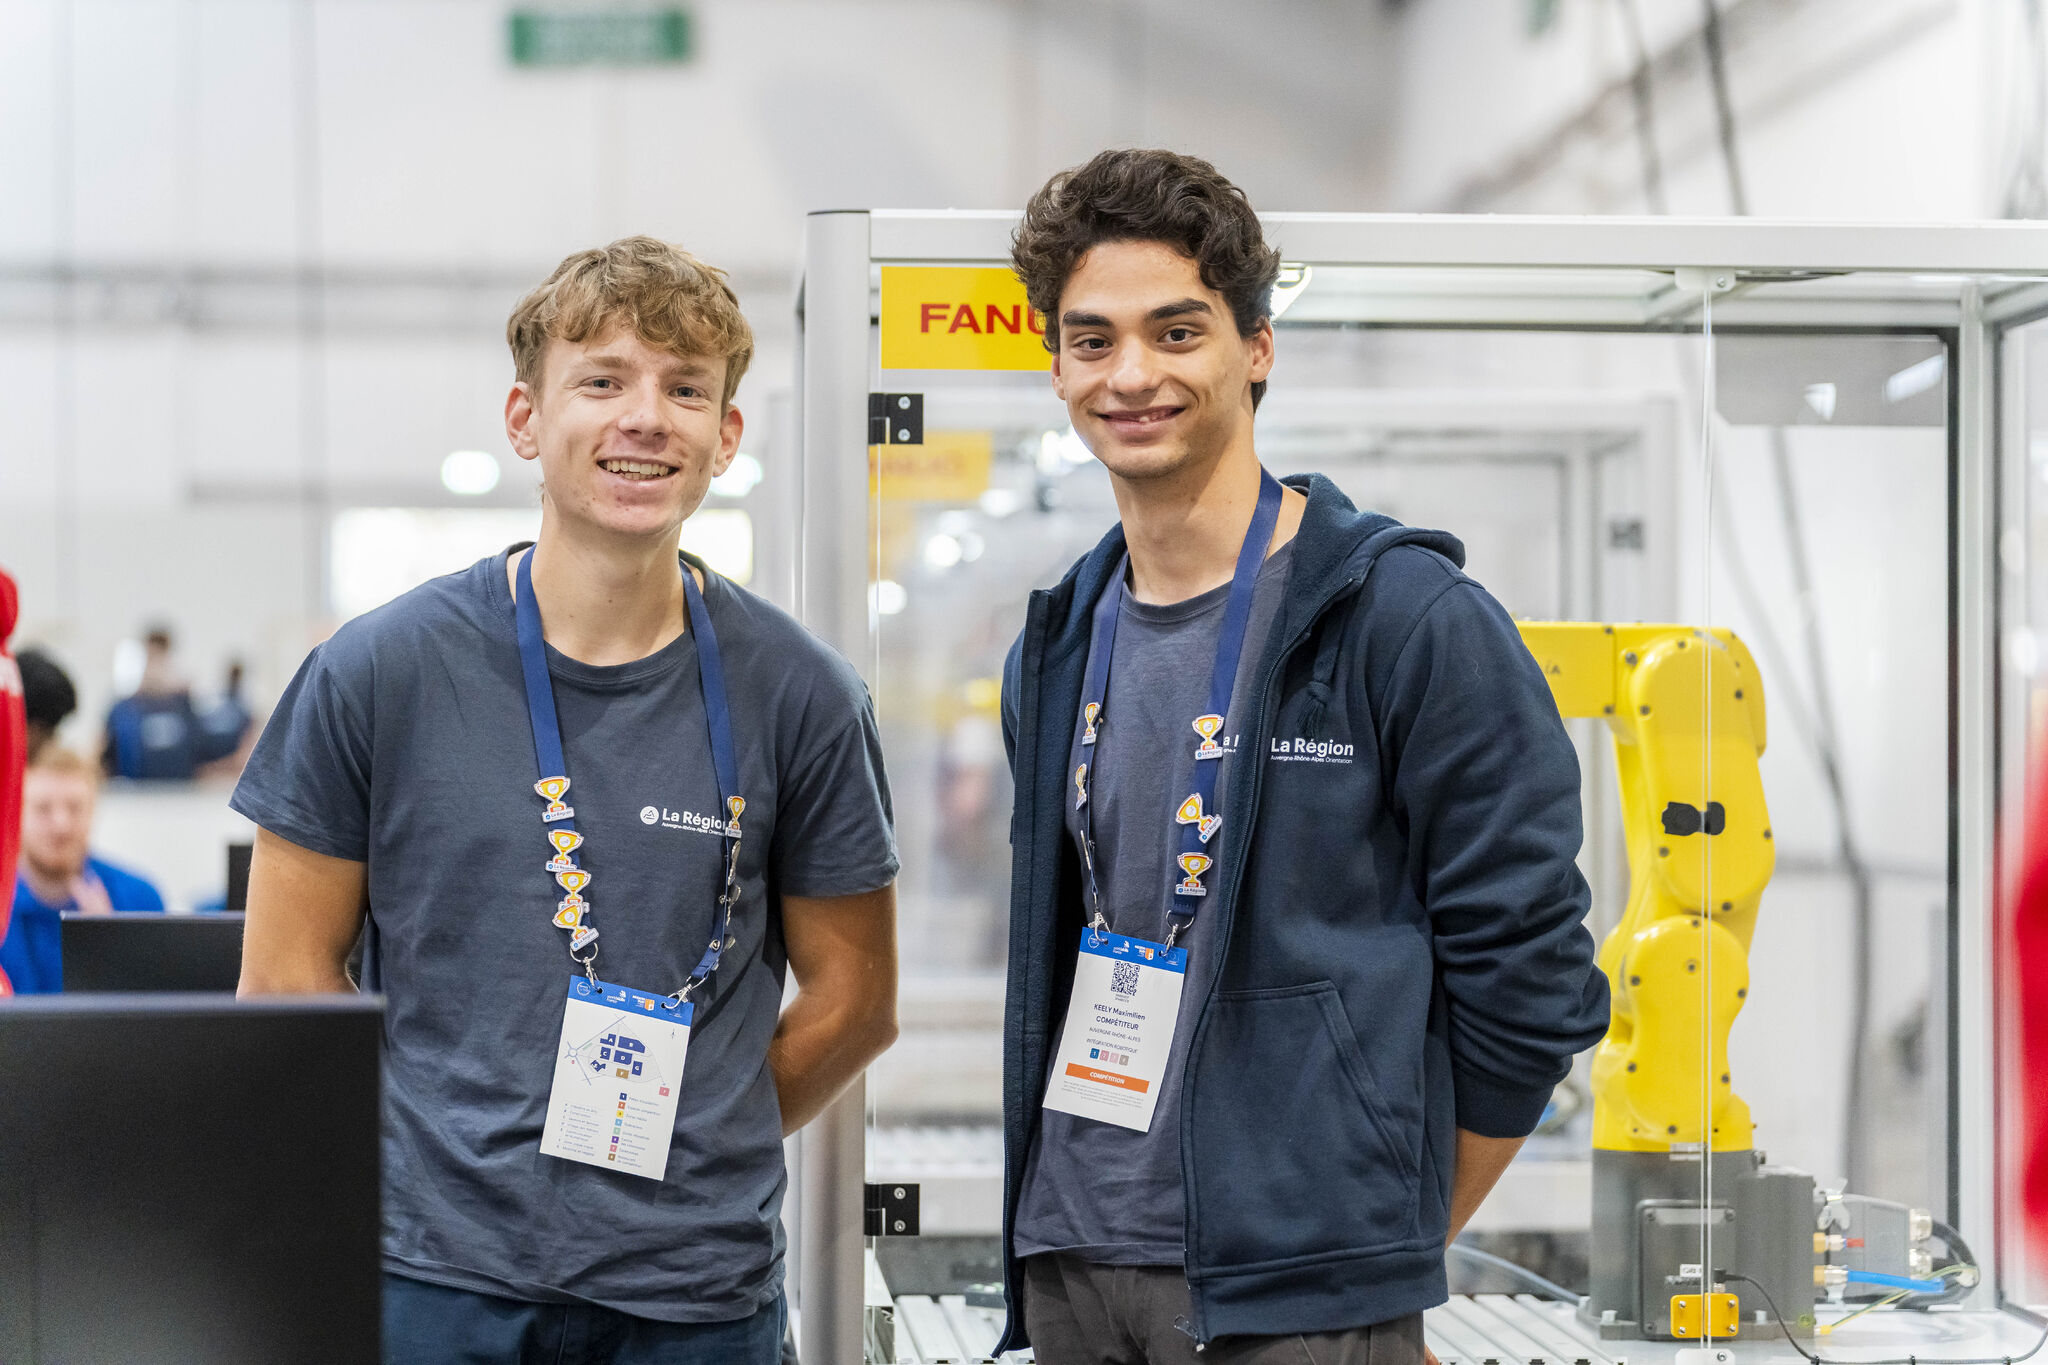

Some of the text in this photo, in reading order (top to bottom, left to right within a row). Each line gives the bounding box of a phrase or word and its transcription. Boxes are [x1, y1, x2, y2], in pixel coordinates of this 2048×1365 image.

[1271, 737, 1354, 758] La Région
[662, 808, 680, 822] La
[1093, 1003, 1146, 1020] KEELY Maximilien
[1096, 1015, 1139, 1030] COMPÉTITEUR
[1089, 1071, 1125, 1084] COMPÉTITION
